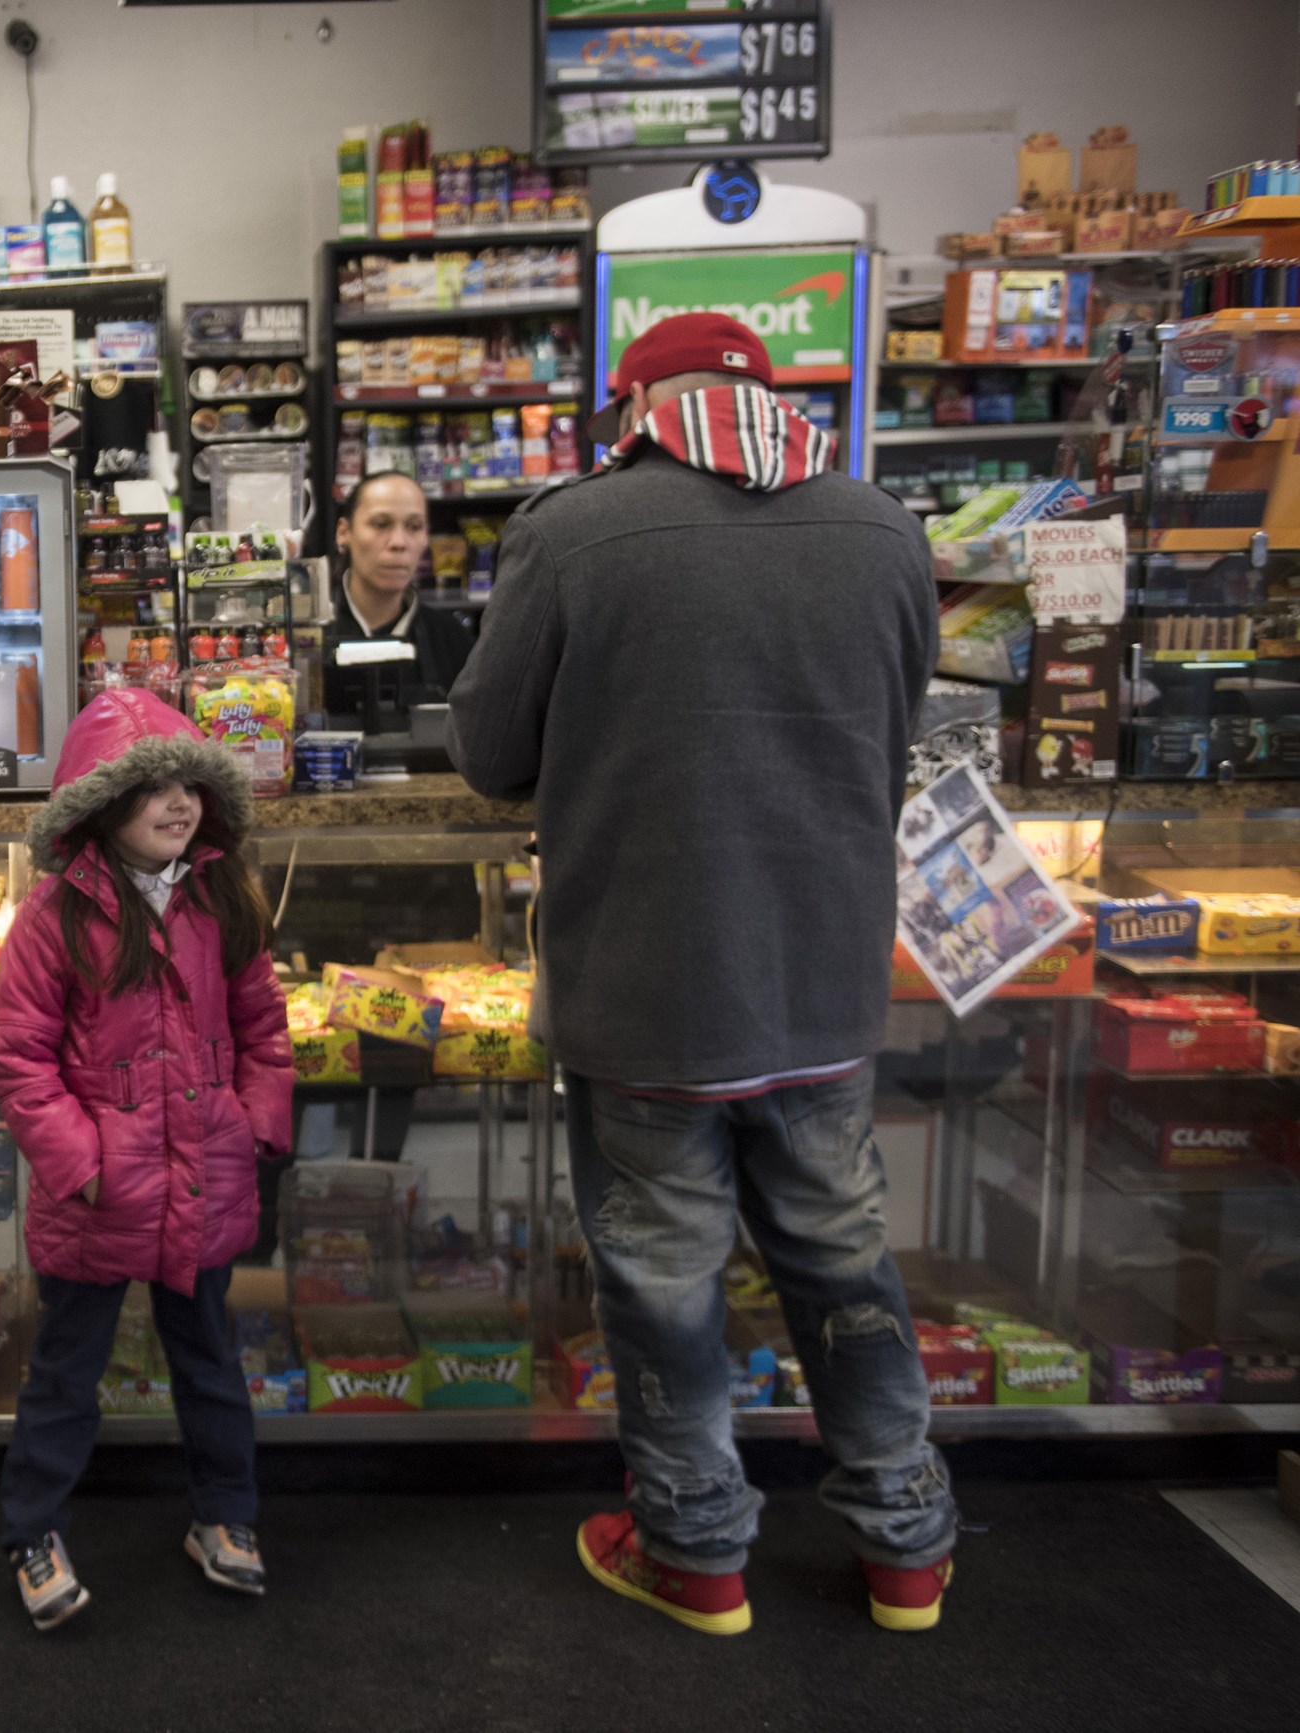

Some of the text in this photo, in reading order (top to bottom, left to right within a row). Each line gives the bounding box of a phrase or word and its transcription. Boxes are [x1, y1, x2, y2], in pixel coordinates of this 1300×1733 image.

[581, 27, 706, 66] CAMEL
[634, 96, 709, 123] SILVER
[1182, 348, 1223, 358] SWISHER
[1174, 412, 1212, 427] 1998
[1031, 527, 1096, 541] MOVIES
[1080, 547, 1123, 562] EACH
[218, 703, 254, 721] Laffy
[226, 719, 262, 736] Taffy
[1171, 1127, 1251, 1147] CLARK
[436, 1357, 520, 1383] PUNCH
[1006, 1363, 1080, 1386] Skittles
[326, 1370, 410, 1400] PUNCH
[1130, 1377, 1205, 1397] Skittles
